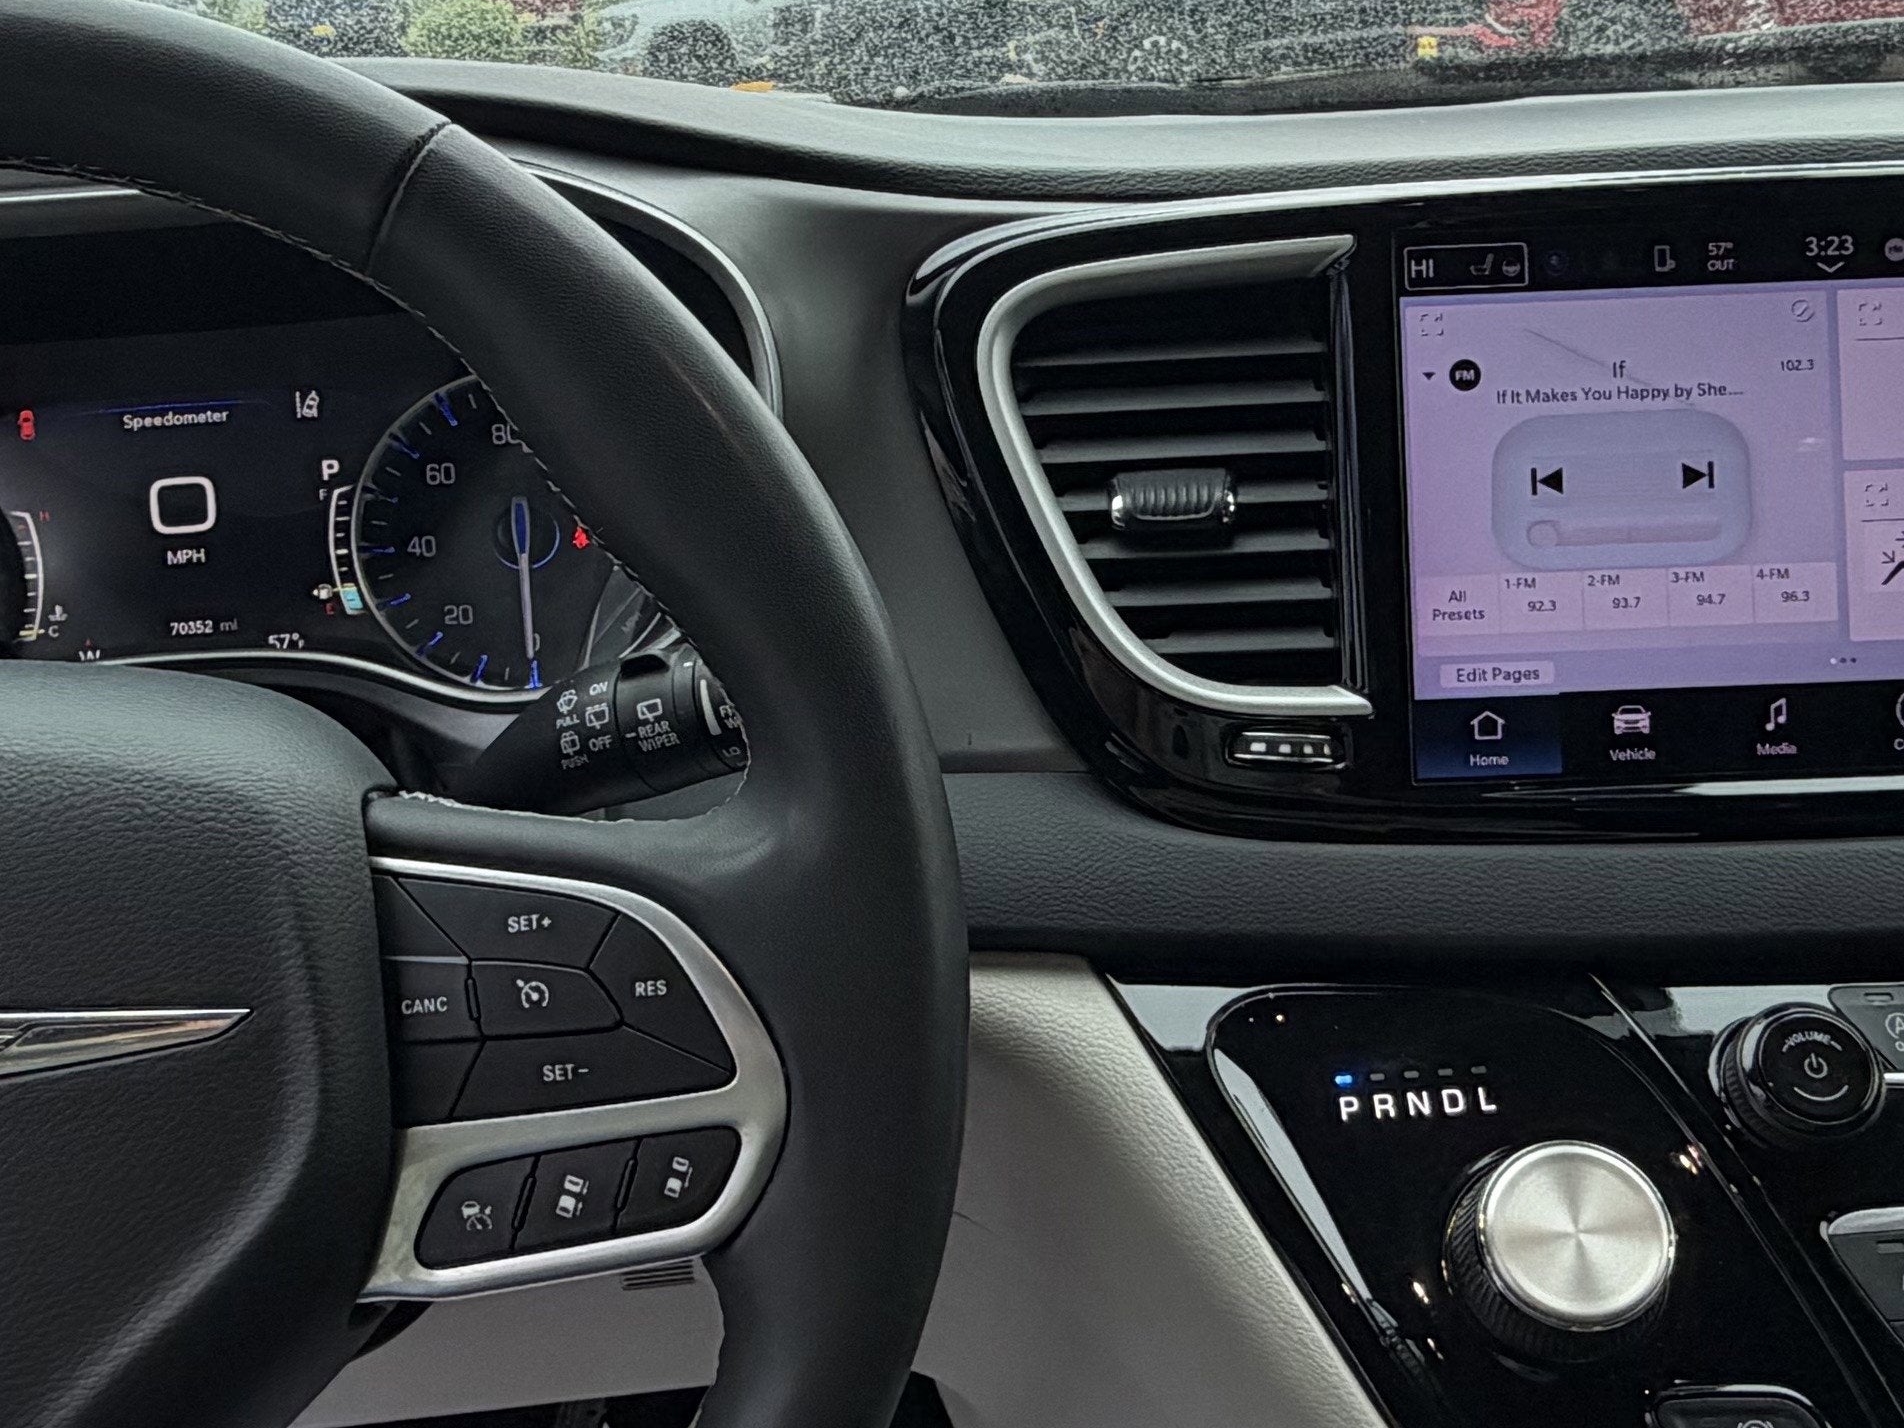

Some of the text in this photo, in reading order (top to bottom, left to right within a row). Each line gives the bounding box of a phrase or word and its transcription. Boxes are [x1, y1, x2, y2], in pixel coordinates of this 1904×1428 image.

[1805, 236, 1854, 257] 3:23
[1410, 260, 1435, 278] HI
[1707, 258, 1735, 272] OUT
[1612, 361, 1626, 379] If
[1780, 358, 1815, 372] 102.3
[1496, 389, 1507, 404] If
[1511, 388, 1523, 404] It
[1526, 387, 1577, 403] Makes
[1582, 387, 1612, 402] You
[1617, 384, 1670, 404] Happy
[1674, 383, 1693, 401] by
[123, 409, 229, 431] Speedometer
[321, 459, 340, 481] P
[425, 462, 456, 485] 60
[318, 489, 329, 501] F
[149, 475, 217, 535] 0
[38, 511, 51, 523] H
[407, 535, 437, 558] 40
[166, 547, 206, 567] MPH
[1587, 574, 1620, 586] 2-FM
[1670, 571, 1705, 584] 3-FM
[1756, 568, 1790, 580] 4-FM
[1504, 577, 1536, 589] 1-FM
[1449, 590, 1467, 604] All
[1612, 596, 1641, 609] 93.7
[1696, 593, 1726, 607] 94.7
[1781, 590, 1810, 603] 96.3
[1527, 599, 1557, 612] 92.3
[443, 603, 474, 626] 20
[1433, 606, 1485, 622] Presets
[48, 625, 60, 638] C
[169, 618, 238, 636] 70352 mi
[1456, 666, 1540, 685] Edit Pages
[589, 681, 608, 696] ON
[638, 721, 671, 738] REAR
[588, 734, 613, 752] OFF
[637, 733, 681, 752] WIPER
[1756, 741, 1798, 756] Media
[1470, 753, 1509, 767] Home
[1609, 747, 1656, 762] Vehicle
[635, 980, 667, 997] RES
[401, 996, 448, 1015] CANC
[1785, 1030, 1831, 1047] VOLUME
